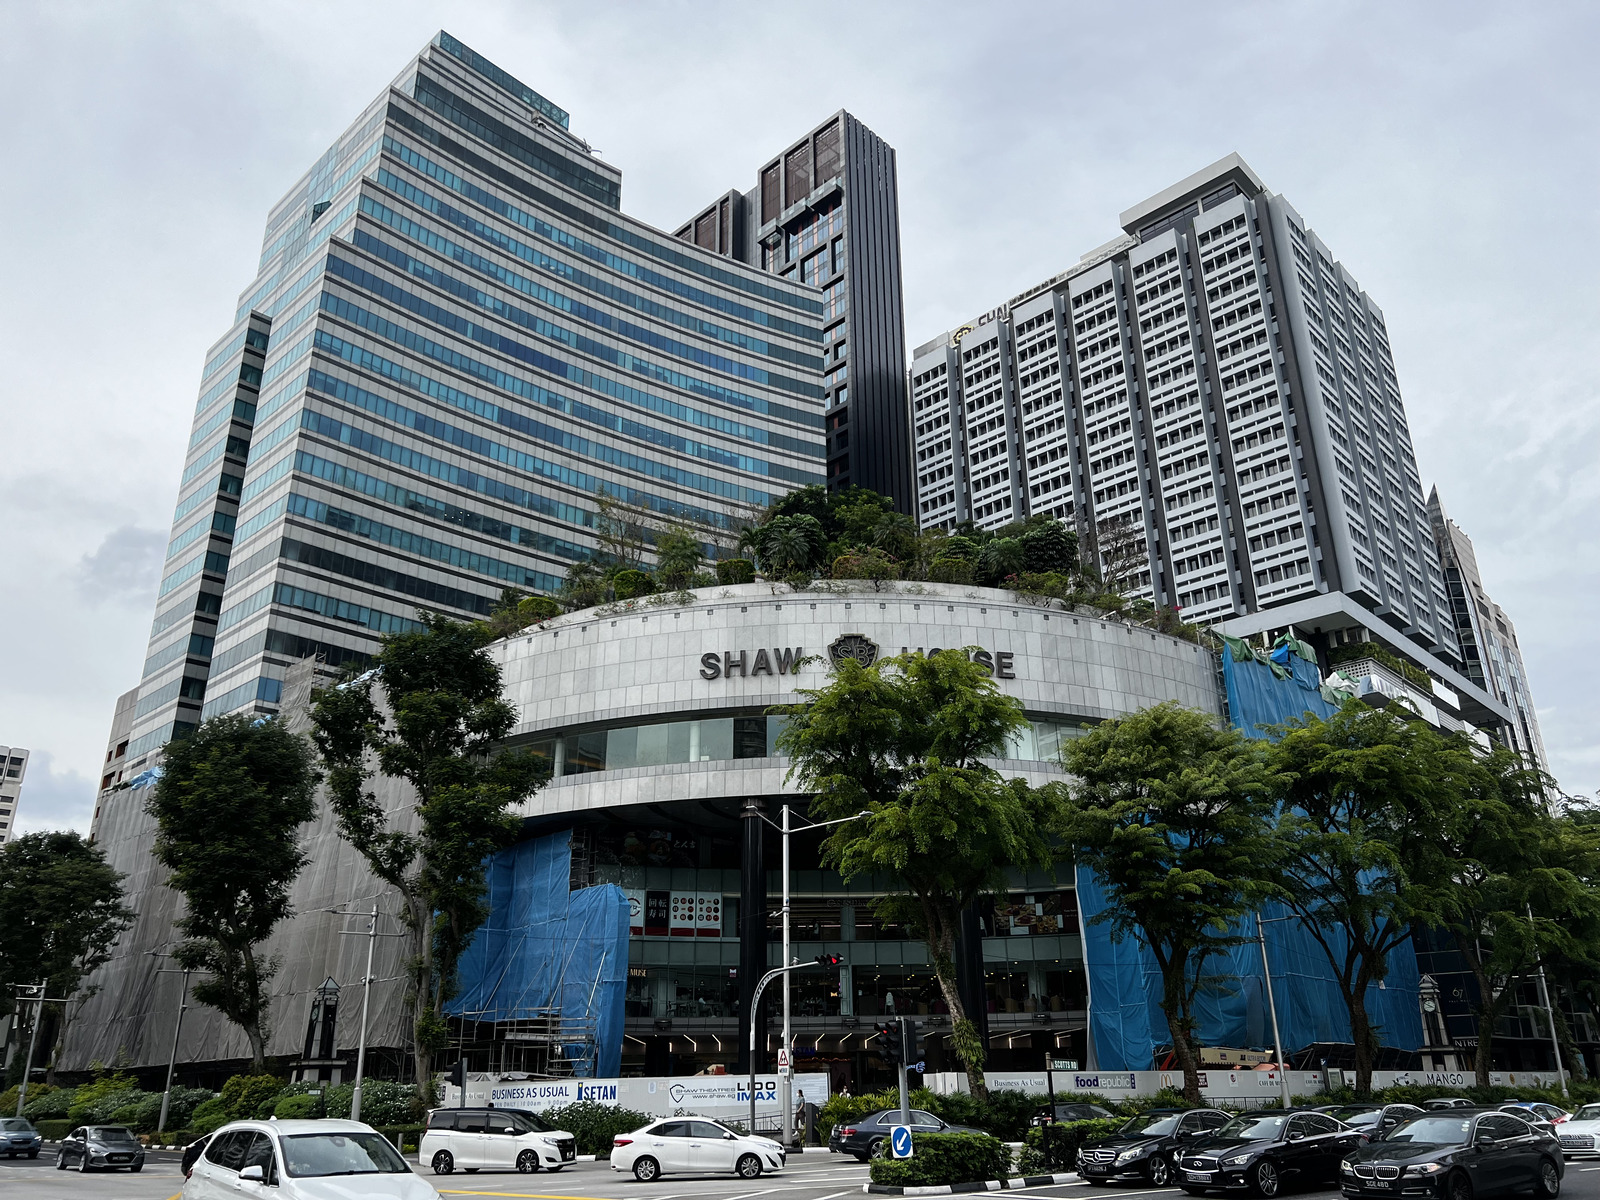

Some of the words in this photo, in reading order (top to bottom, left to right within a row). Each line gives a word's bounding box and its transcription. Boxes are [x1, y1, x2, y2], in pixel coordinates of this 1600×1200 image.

[700, 647, 803, 680] SHAW
[1054, 1060, 1070, 1069] SCOTTS
[1426, 1073, 1464, 1085] MANGO
[492, 1088, 524, 1099] BUSINESS
[526, 1088, 537, 1098] AS
[540, 1086, 569, 1097] USUAL
[576, 1082, 617, 1101] ISETAN
